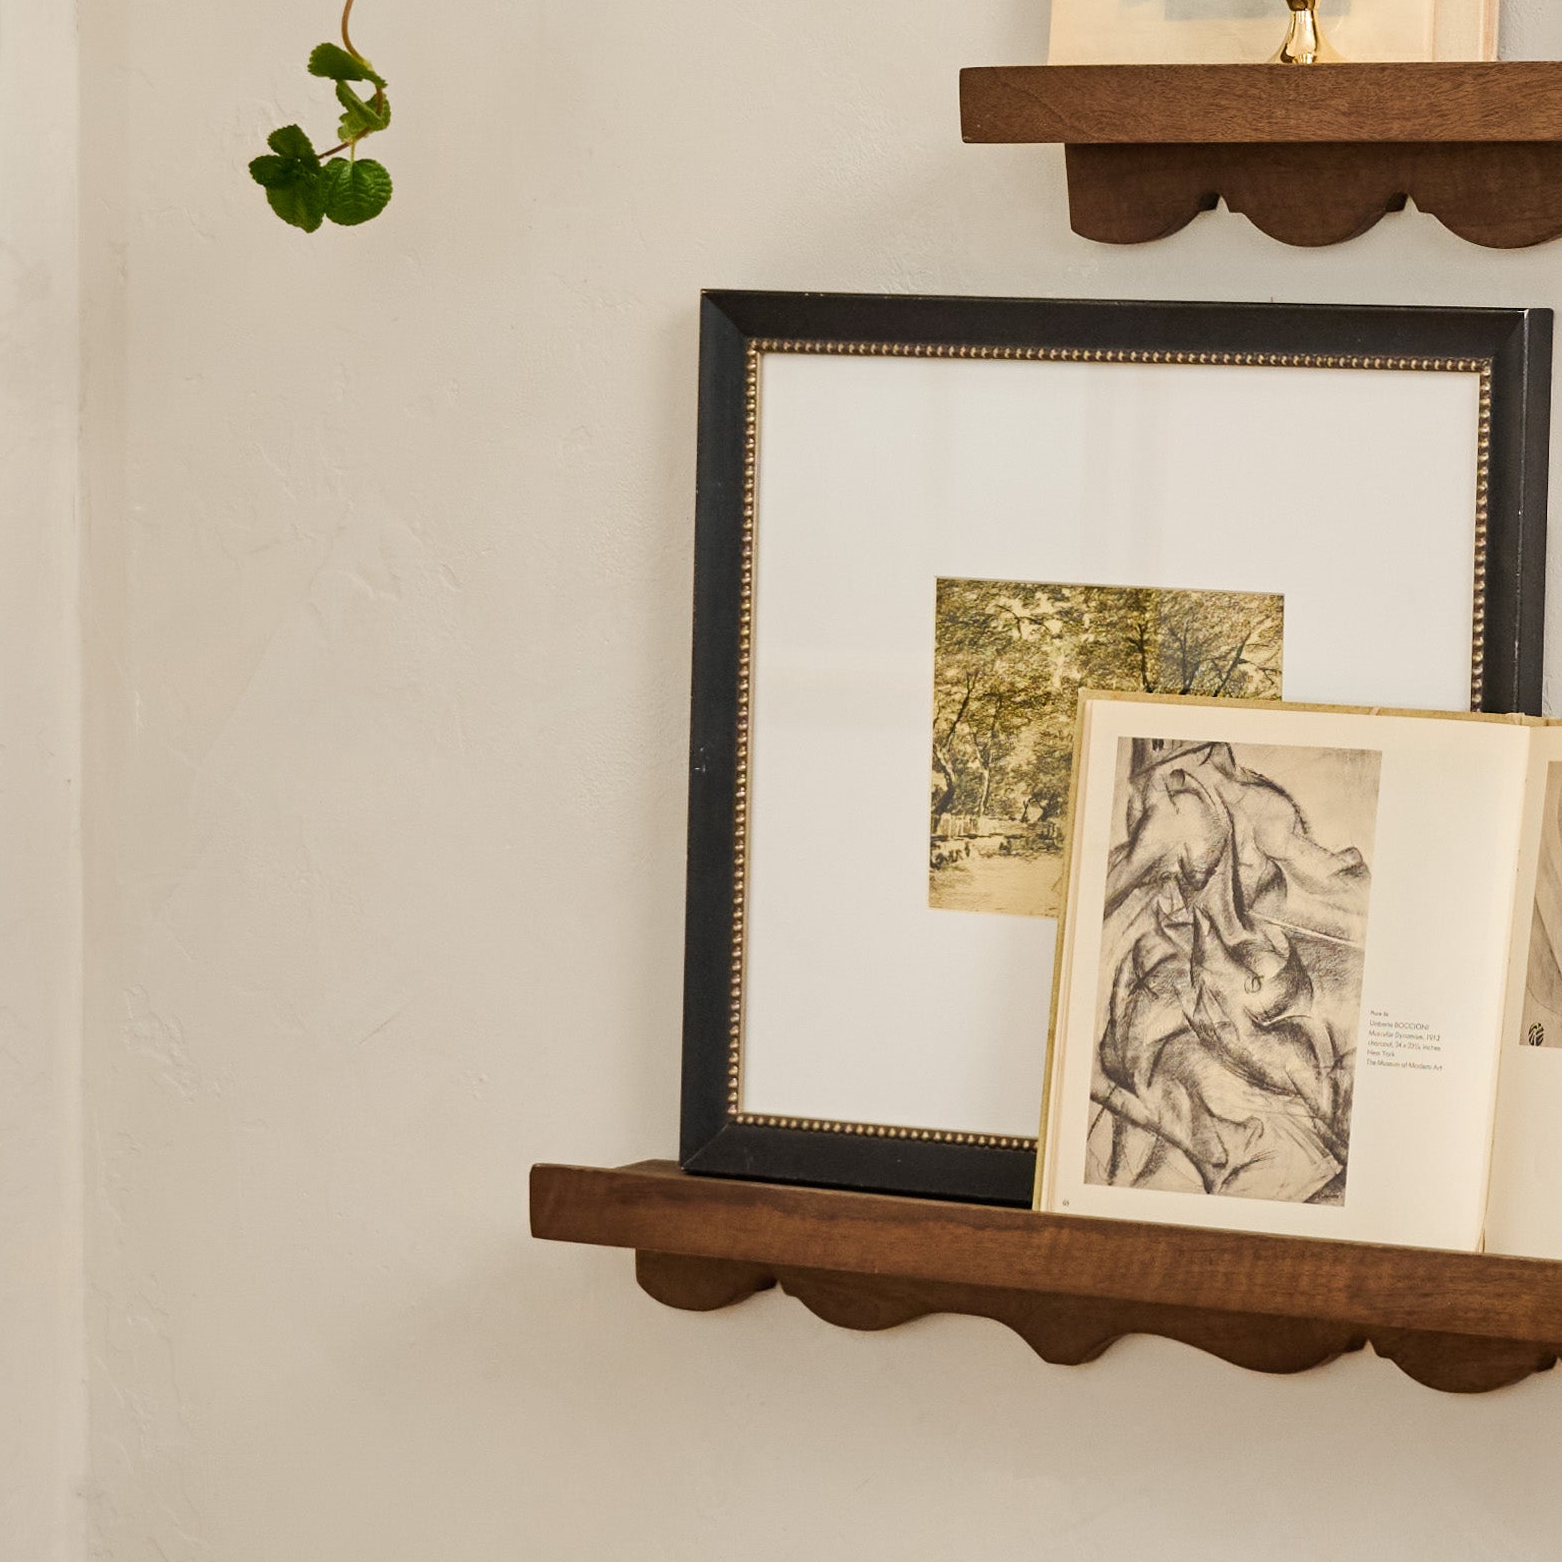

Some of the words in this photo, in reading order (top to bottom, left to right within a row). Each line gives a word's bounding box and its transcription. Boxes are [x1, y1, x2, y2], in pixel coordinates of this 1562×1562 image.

[1394, 1021, 1430, 1031] BOCCIONI
[1366, 1058, 1376, 1066] The
[1377, 1059, 1400, 1067] Museum
[1408, 1062, 1431, 1070] Modern
